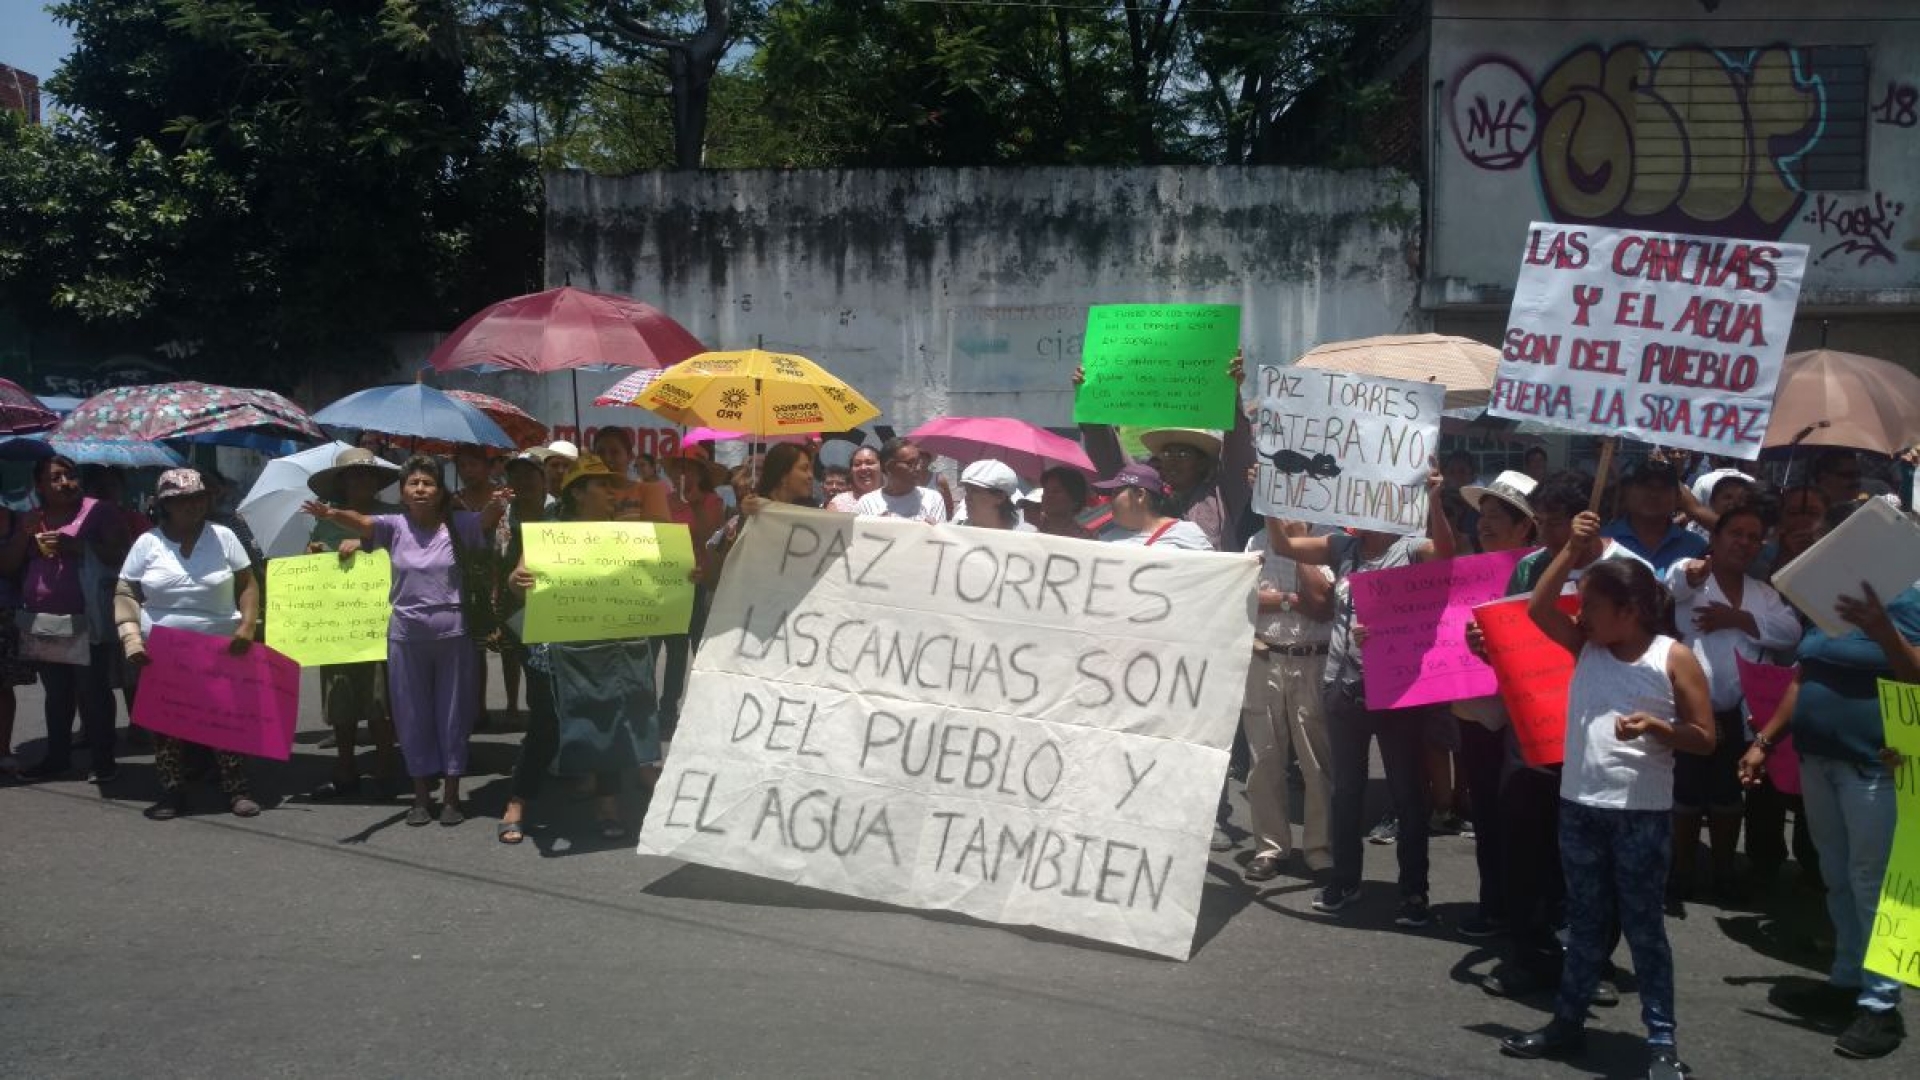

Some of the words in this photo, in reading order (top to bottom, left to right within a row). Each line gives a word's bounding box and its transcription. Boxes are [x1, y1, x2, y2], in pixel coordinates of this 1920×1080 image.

[1525, 230, 1590, 269] LAS
[1612, 236, 1782, 293] CANCHAS
[1571, 285, 1604, 327] Y
[1614, 292, 1665, 330] EL
[1671, 296, 1769, 347] AGUA
[1502, 328, 1562, 366] SON
[1568, 338, 1627, 376] DEL
[1638, 342, 1760, 393] PUEBLO
[1262, 366, 1304, 398] PAZ
[1322, 373, 1420, 420] TORRES
[1492, 378, 1575, 419] FUERA
[1589, 388, 1627, 426] LA
[1635, 393, 1693, 436] SRA
[1700, 402, 1768, 444] PAZ
[1259, 408, 1365, 463] RATERA
[1378, 424, 1424, 469] NO
[583, 531, 601, 545] de
[780, 523, 895, 590] PAZ
[927, 538, 1173, 624] TORRES
[1077, 652, 1207, 710] SON
[730, 692, 825, 758] DEL
[860, 711, 1064, 802] PUEBLO
[1115, 751, 1157, 809] Y
[664, 769, 729, 835] EL
[750, 787, 902, 867] AGUA
[932, 811, 1174, 912] TAMBIEN
